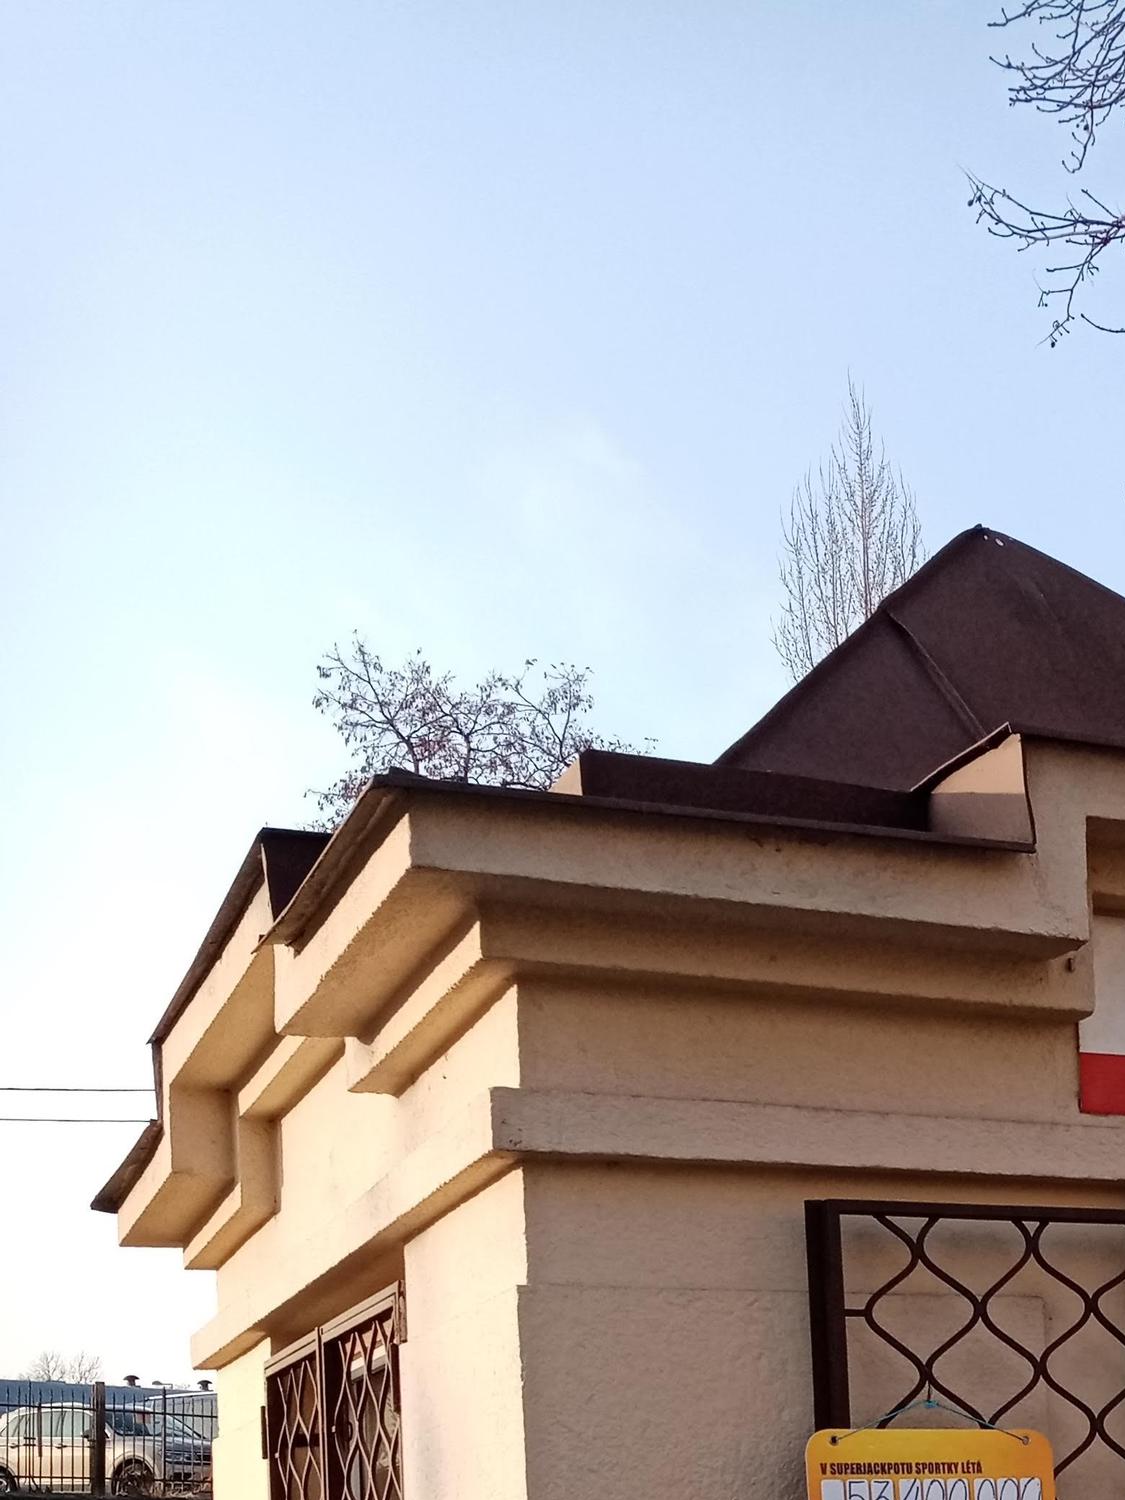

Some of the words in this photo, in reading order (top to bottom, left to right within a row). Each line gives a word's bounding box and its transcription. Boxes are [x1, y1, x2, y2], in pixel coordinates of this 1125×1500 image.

[820, 1463, 827, 1475] V
[830, 1462, 913, 1475] SUPERJACKPOTU
[915, 1462, 959, 1474] SPORTKY
